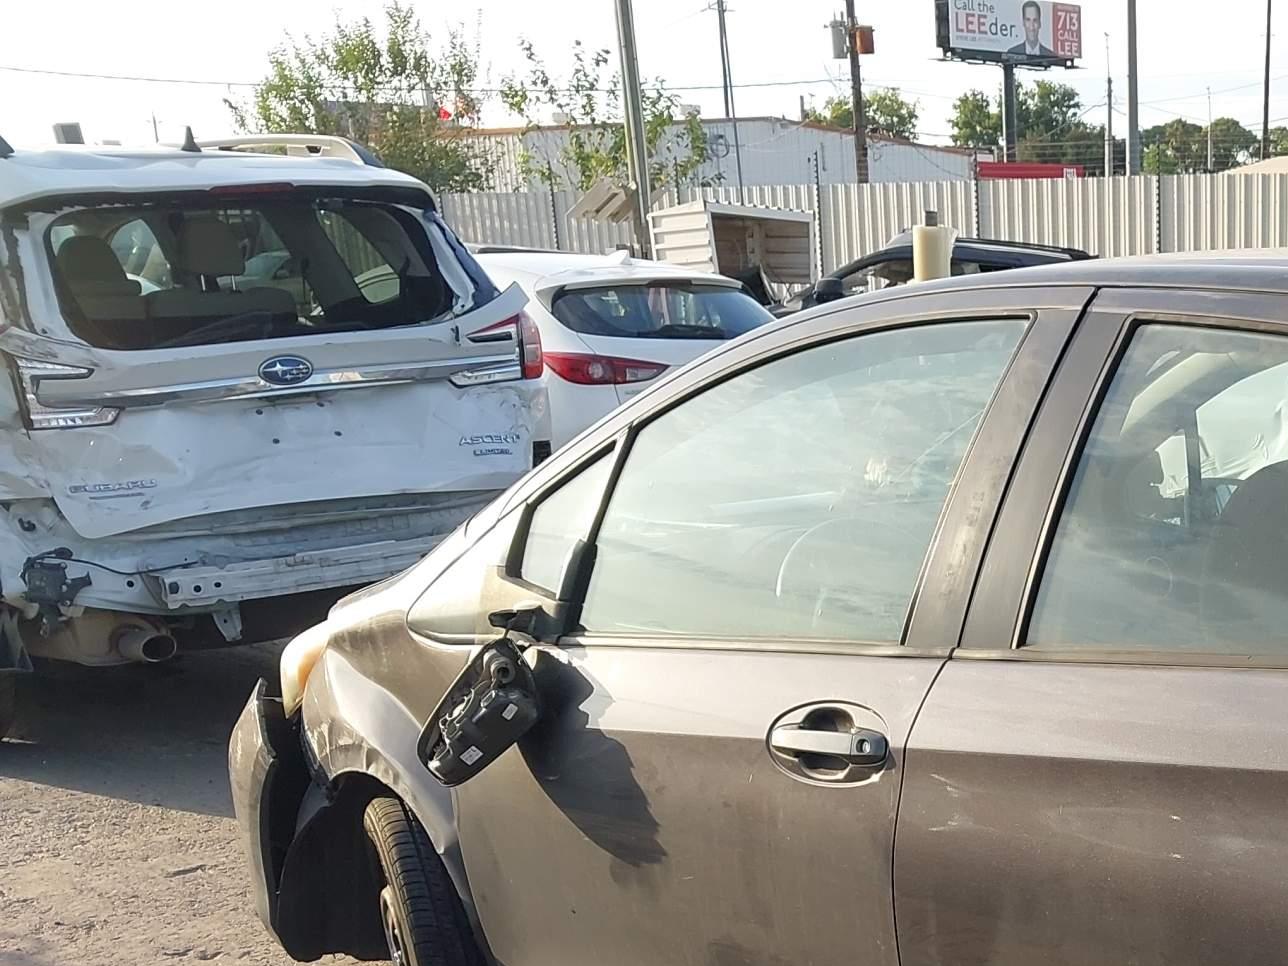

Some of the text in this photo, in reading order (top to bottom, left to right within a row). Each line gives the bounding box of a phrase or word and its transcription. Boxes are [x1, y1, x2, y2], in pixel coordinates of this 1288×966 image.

[954, 0, 995, 14] Call the
[955, 12, 1019, 38] LEEder.
[1057, 11, 1079, 31] 713
[1057, 30, 1079, 41] CALL
[1057, 41, 1079, 56] LEE
